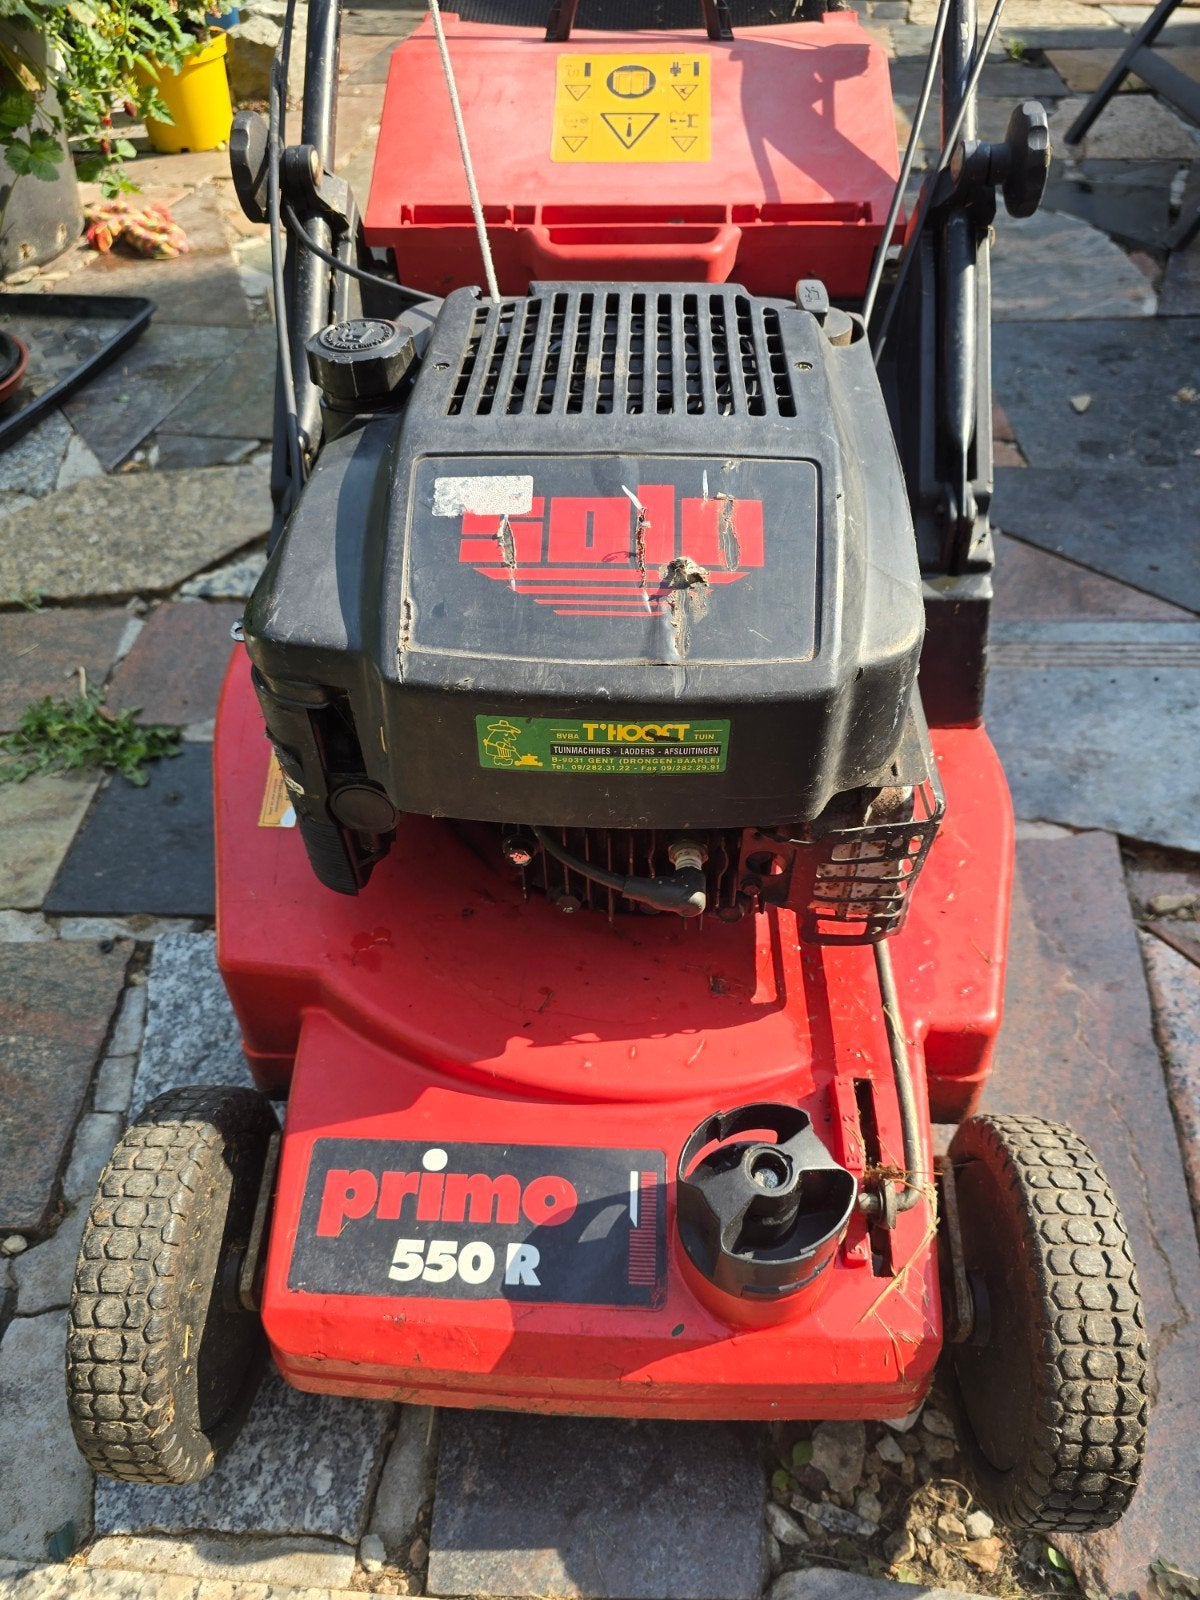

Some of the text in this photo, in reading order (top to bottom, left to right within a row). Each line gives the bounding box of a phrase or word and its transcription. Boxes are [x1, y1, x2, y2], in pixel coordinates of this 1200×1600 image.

[458, 484, 765, 567] solo
[553, 746, 611, 755] TUINMACHINES
[620, 747, 655, 755] LADDERS
[664, 747, 719, 755] AFSLUITINGEN
[316, 1148, 578, 1237] primo
[387, 1238, 541, 1286] 550 R
